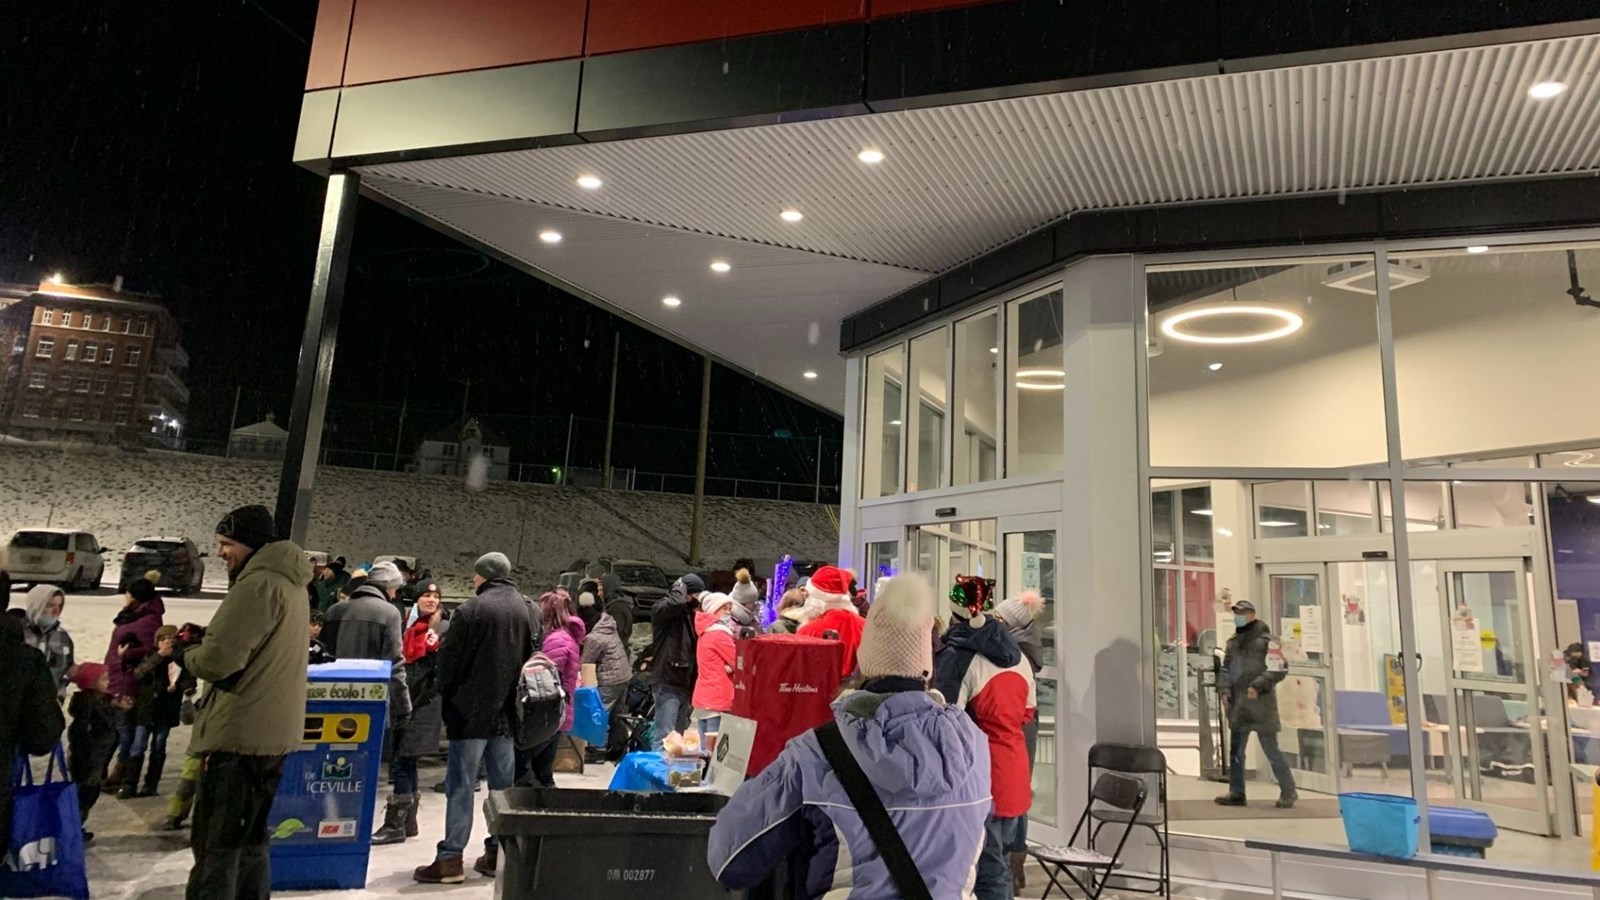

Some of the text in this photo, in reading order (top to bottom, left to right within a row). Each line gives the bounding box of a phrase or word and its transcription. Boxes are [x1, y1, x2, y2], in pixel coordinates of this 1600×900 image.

[779, 683, 791, 692] Tim
[321, 825, 340, 834] IGA
[623, 869, 656, 880] 002877
